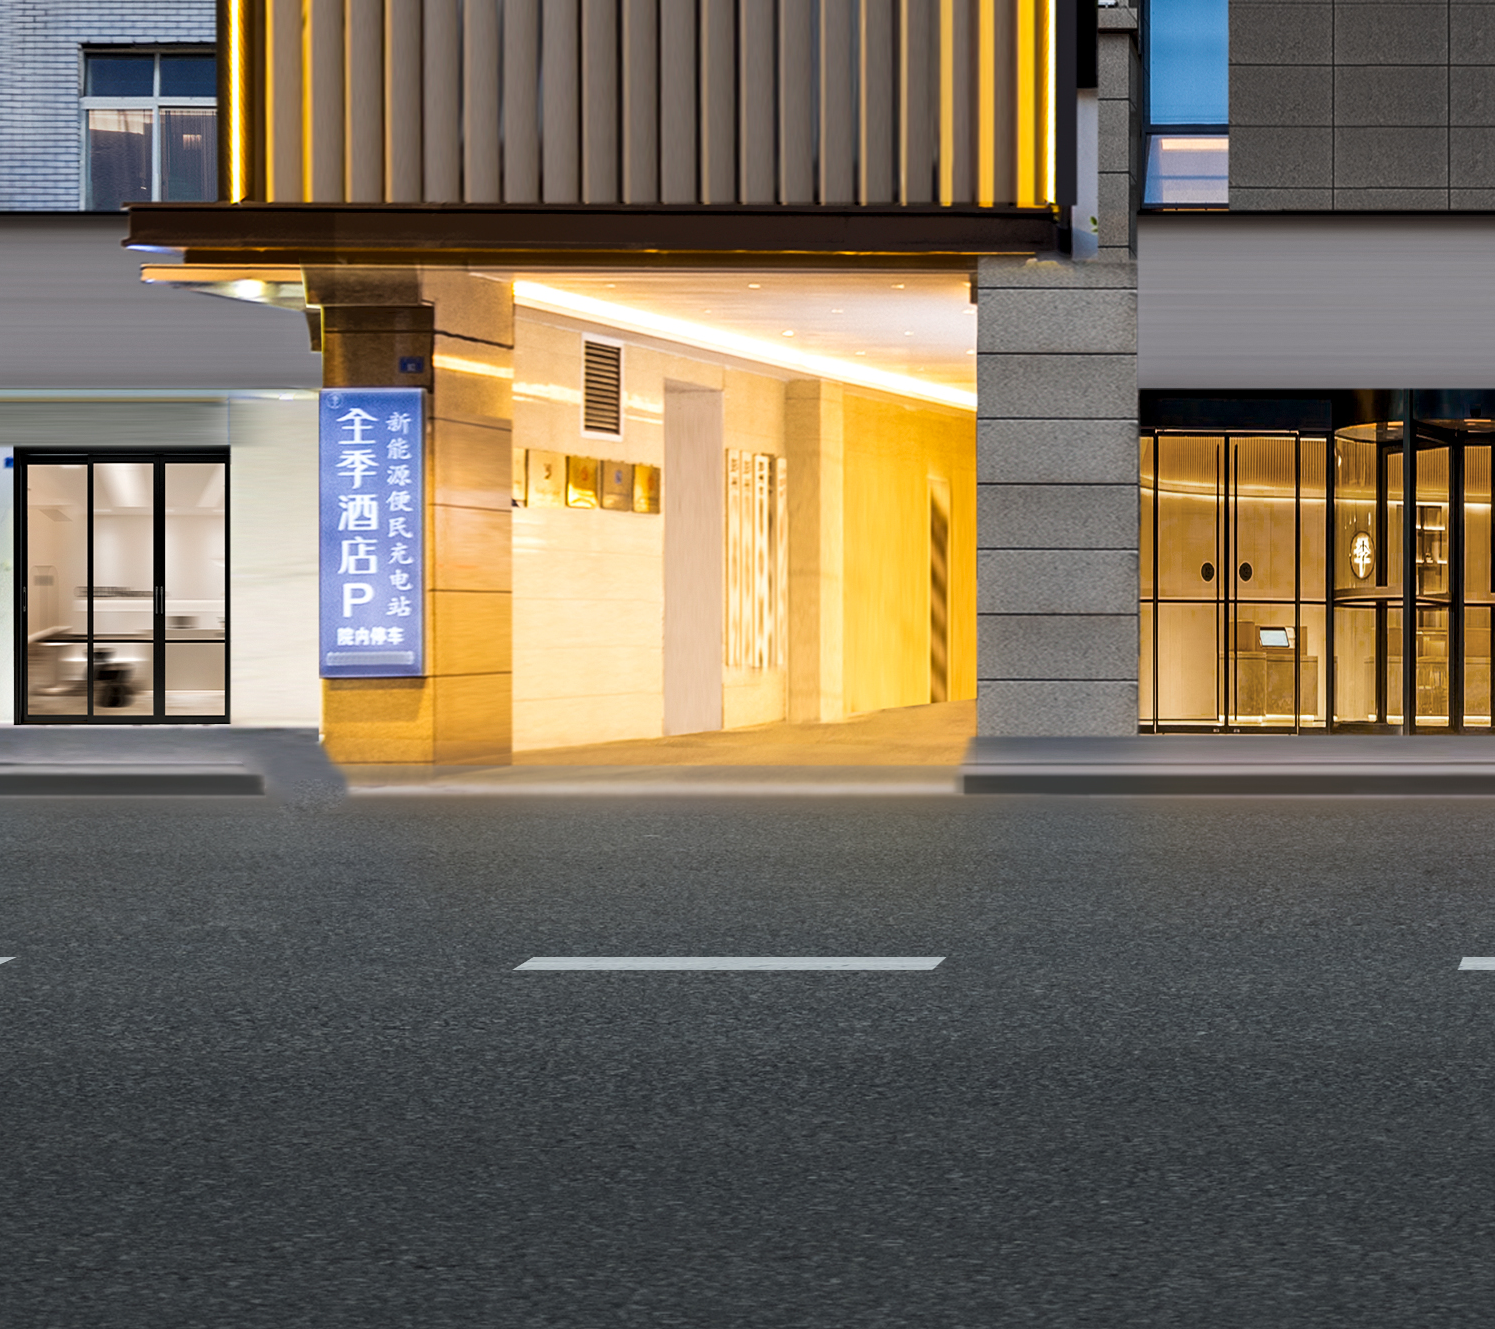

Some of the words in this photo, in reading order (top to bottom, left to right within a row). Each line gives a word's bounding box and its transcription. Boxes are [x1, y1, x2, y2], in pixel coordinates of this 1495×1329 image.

[385, 410, 414, 618] 新能源便民充电站
[336, 626, 405, 646] 院内停车
